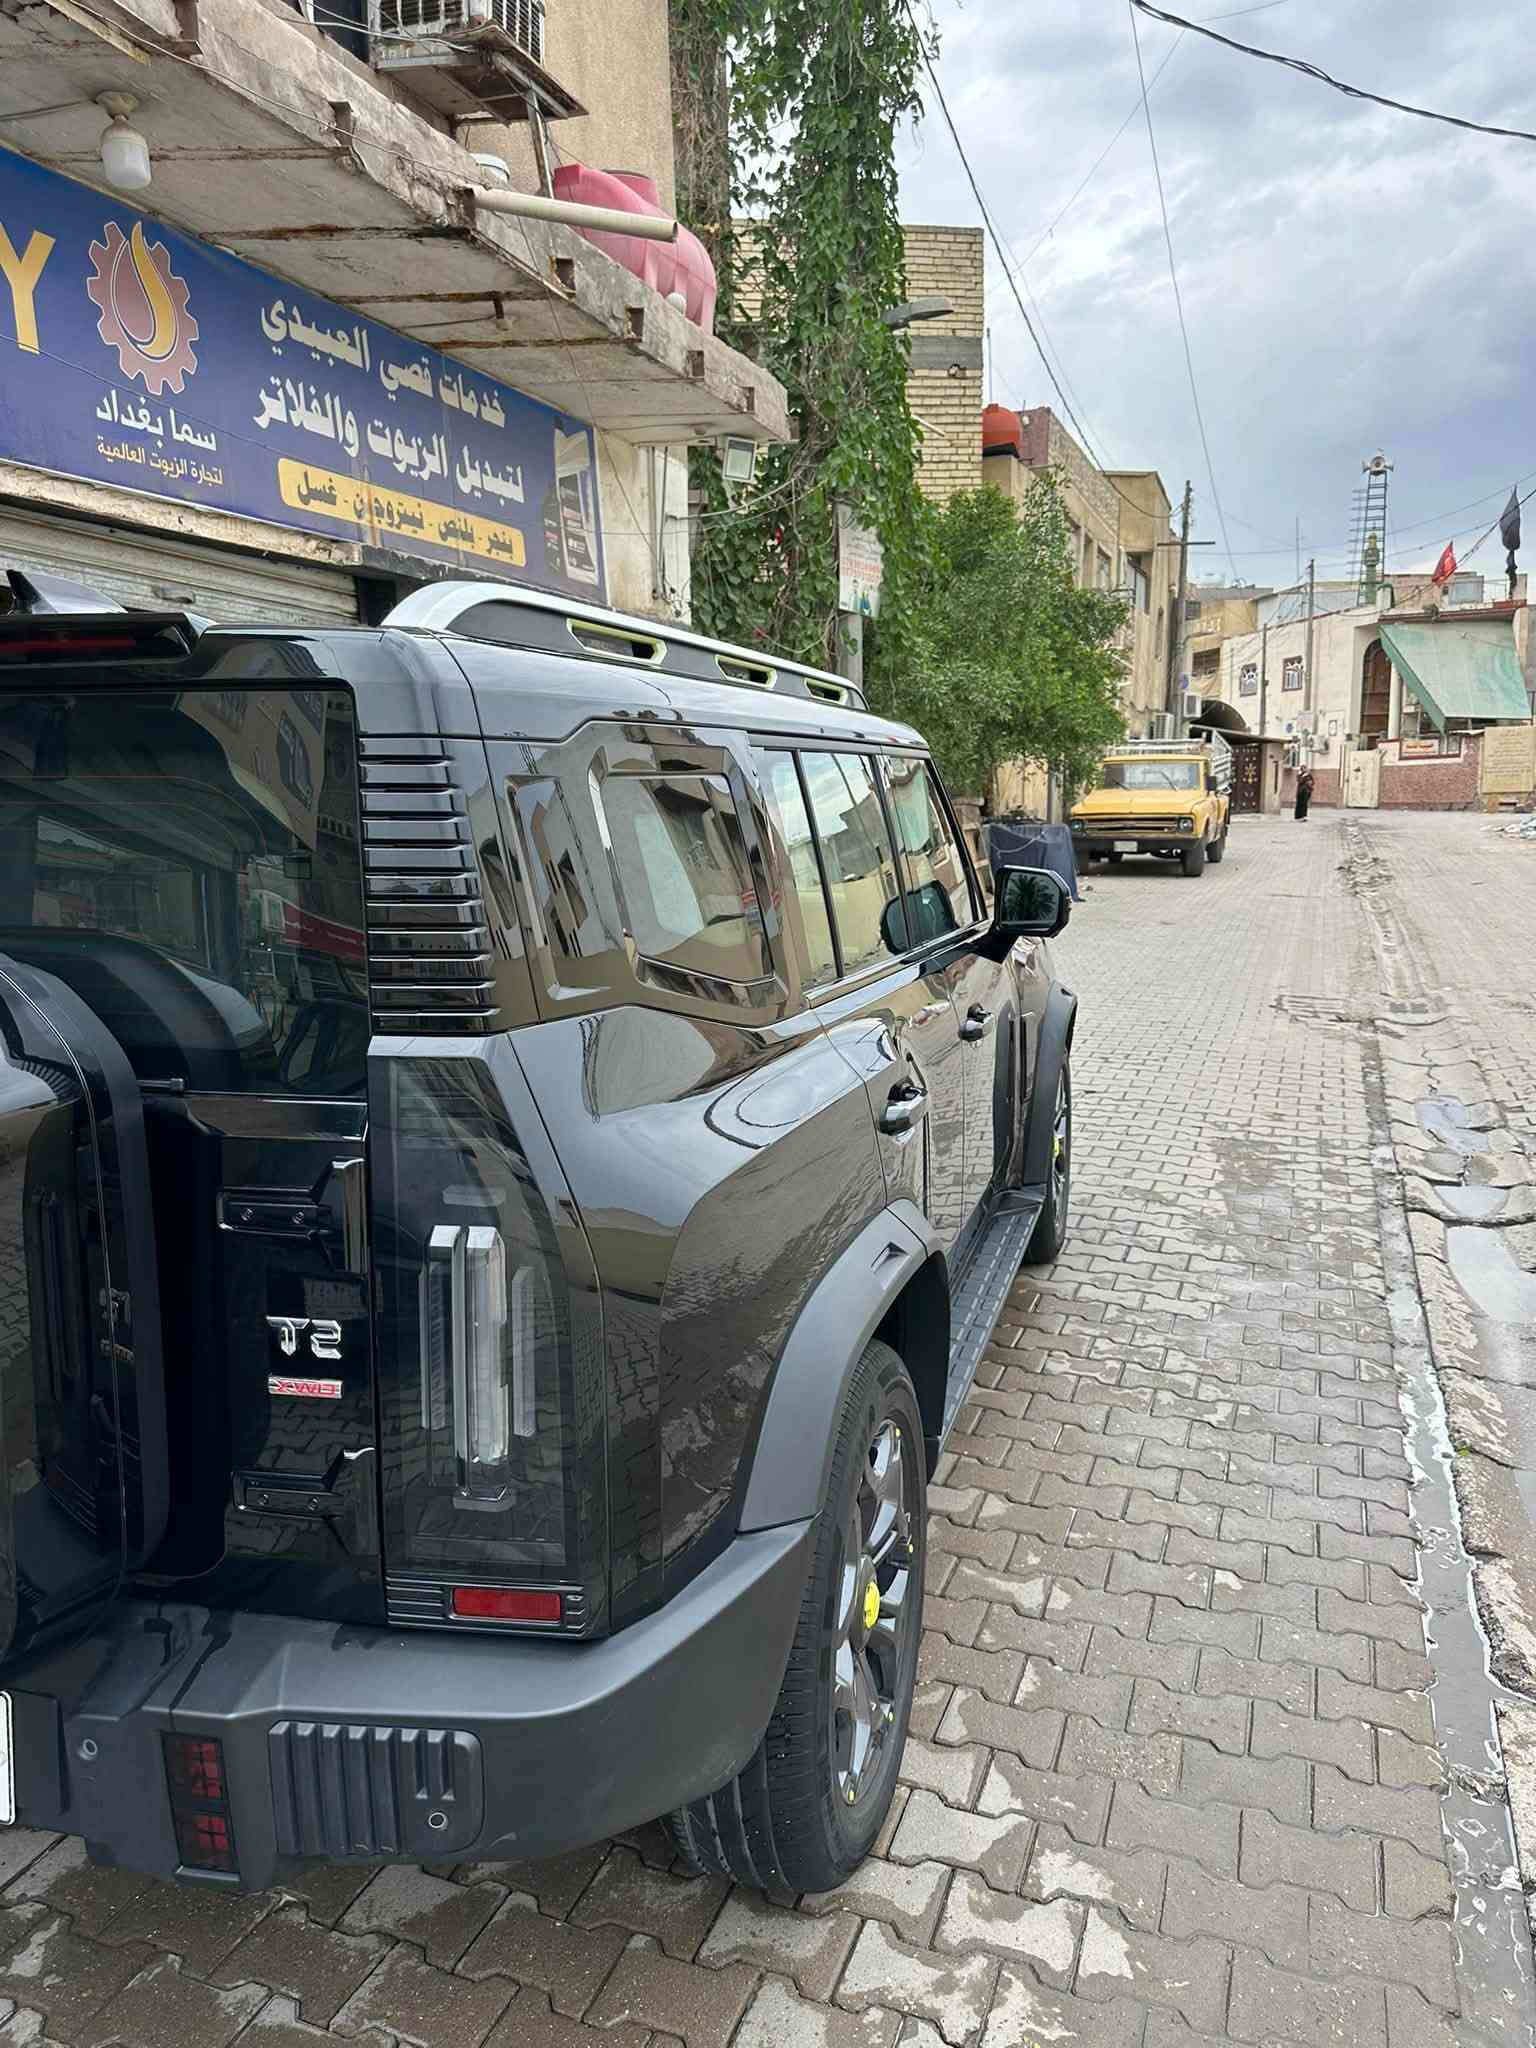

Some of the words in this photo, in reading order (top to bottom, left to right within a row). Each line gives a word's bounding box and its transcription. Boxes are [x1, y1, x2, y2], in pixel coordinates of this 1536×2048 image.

[0, 221, 56, 355] Y
[261, 300, 370, 373] العبيدي
[380, 356, 434, 402] قصي
[439, 373, 505, 428] خدمات
[96, 389, 164, 449] بغداد
[169, 408, 217, 451] سما
[253, 376, 359, 458] والفلاتر
[97, 434, 146, 464] العالمية
[149, 452, 188, 479] الزيوت
[367, 419, 448, 481] الزيوت
[191, 460, 224, 487] لتجارة
[297, 470, 337, 506] غسل
[456, 445, 525, 507] لتبديل
[353, 492, 425, 531] نيتروجن
[487, 530, 514, 561] بنجر
[266, 1315, 342, 1360] T2
